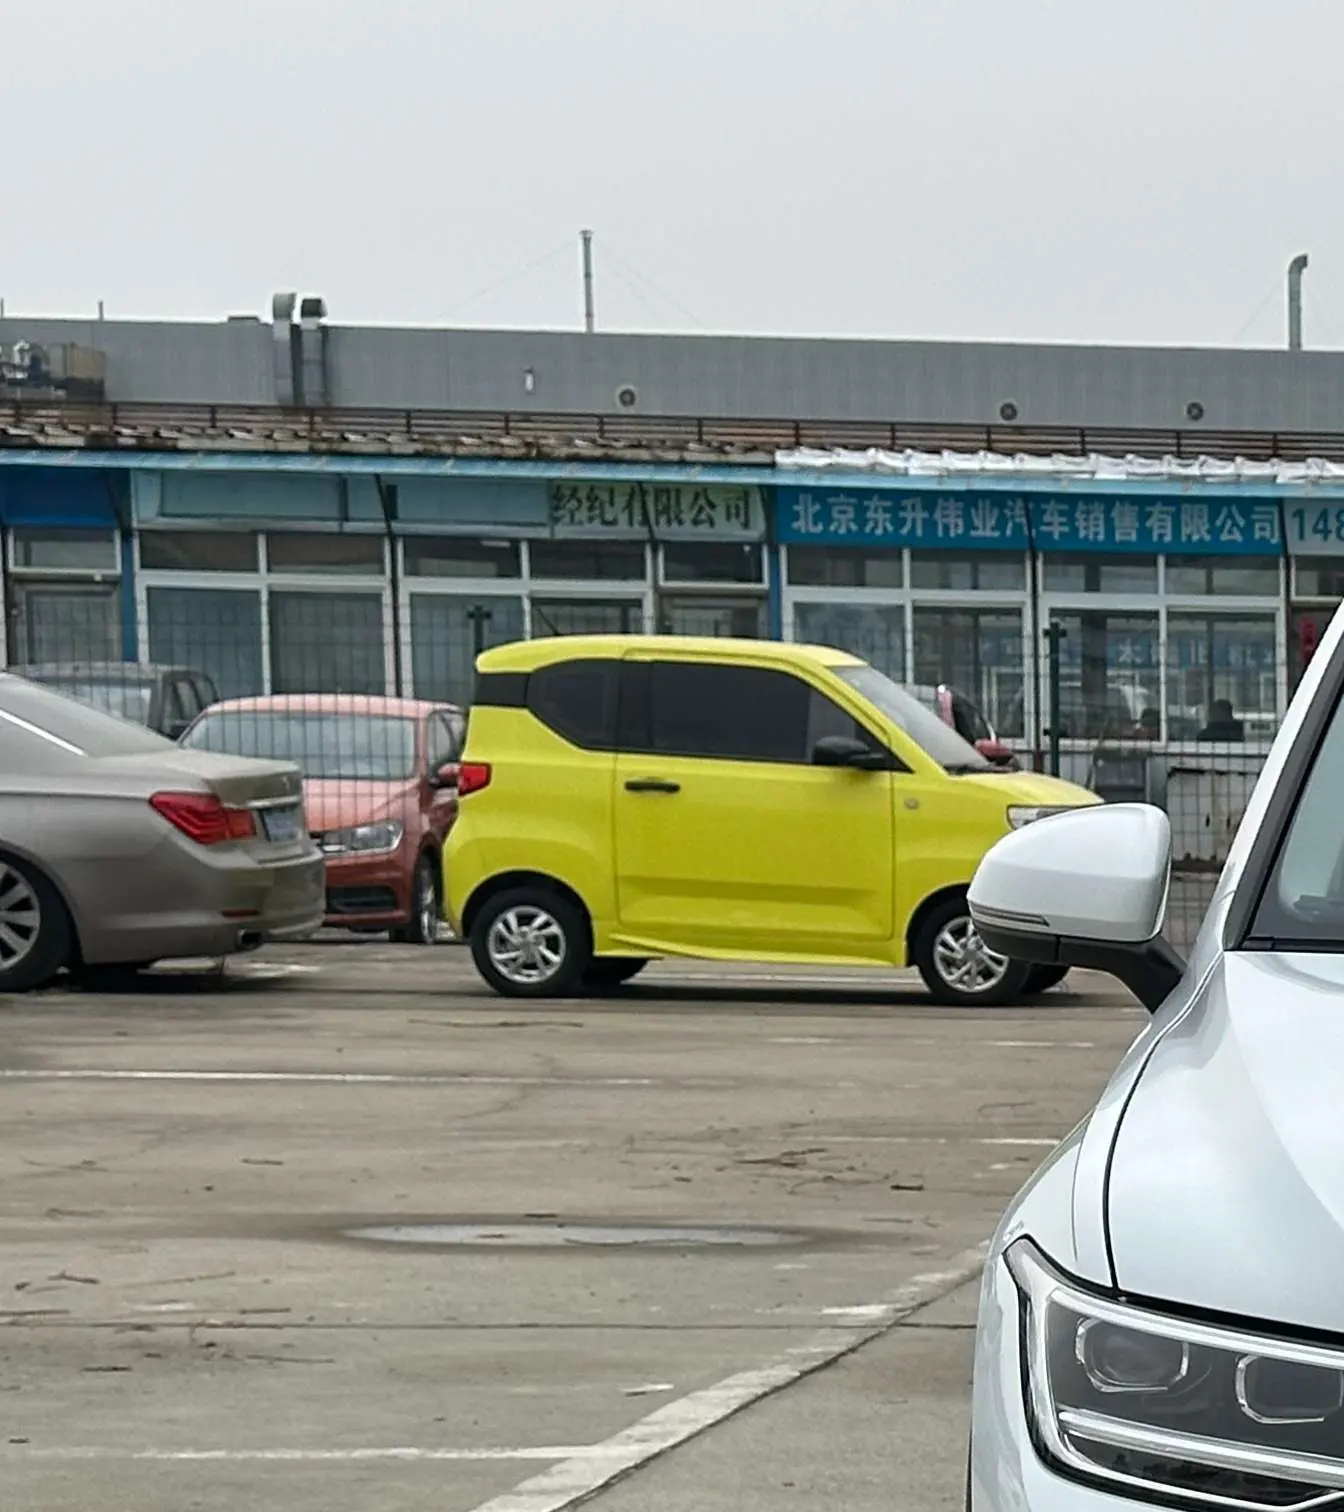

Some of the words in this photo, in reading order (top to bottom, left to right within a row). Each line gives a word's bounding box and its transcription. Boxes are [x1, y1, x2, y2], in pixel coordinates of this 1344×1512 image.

[791, 493, 1279, 544] 北京东升伟业汽车销售有限公司
